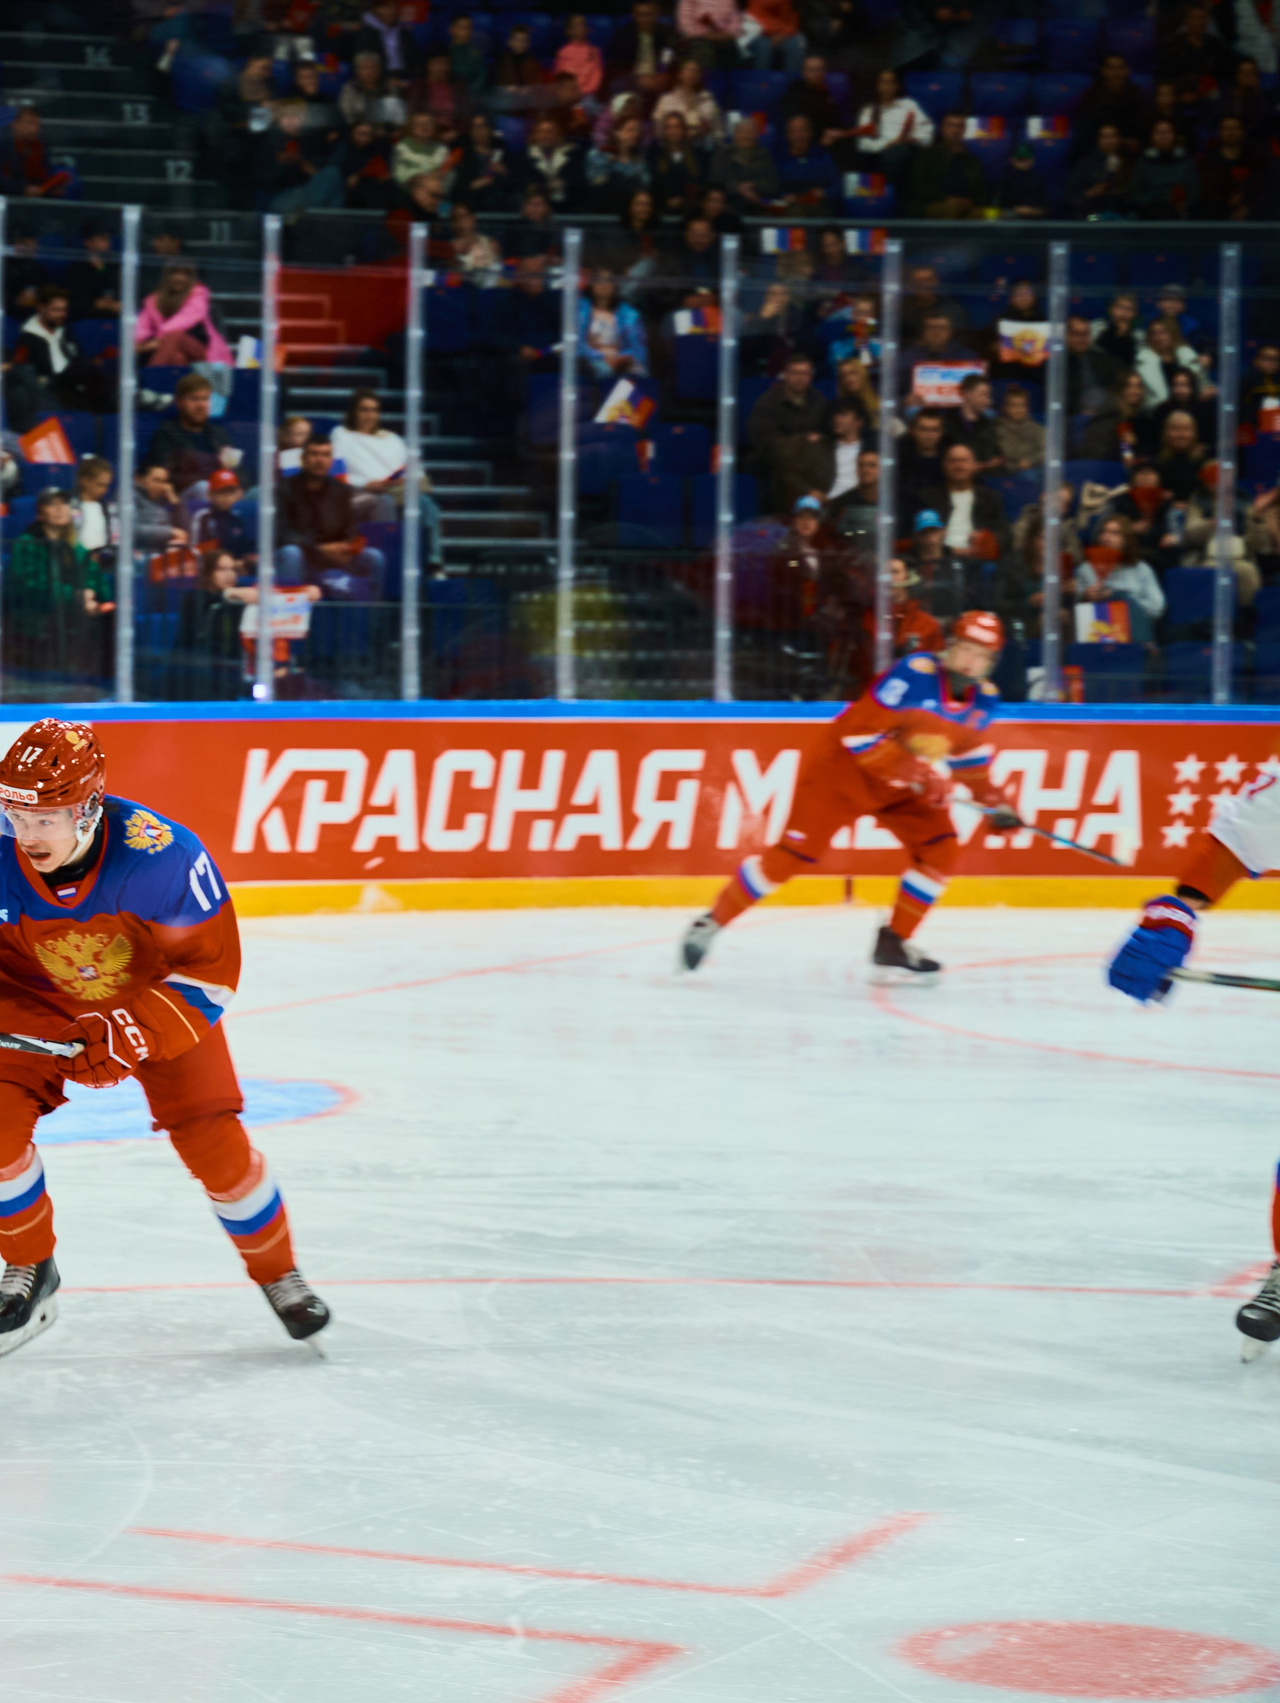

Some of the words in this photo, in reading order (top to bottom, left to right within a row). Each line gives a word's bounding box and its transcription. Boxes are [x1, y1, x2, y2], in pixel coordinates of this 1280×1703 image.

[122, 102, 150, 125] 13
[165, 159, 194, 183] 12
[20, 746, 43, 763] 17
[232, 748, 706, 853] КРАСНАЯ
[718, 748, 1143, 851] МНА
[189, 851, 222, 912] 17
[111, 1008, 150, 1062] CCM
